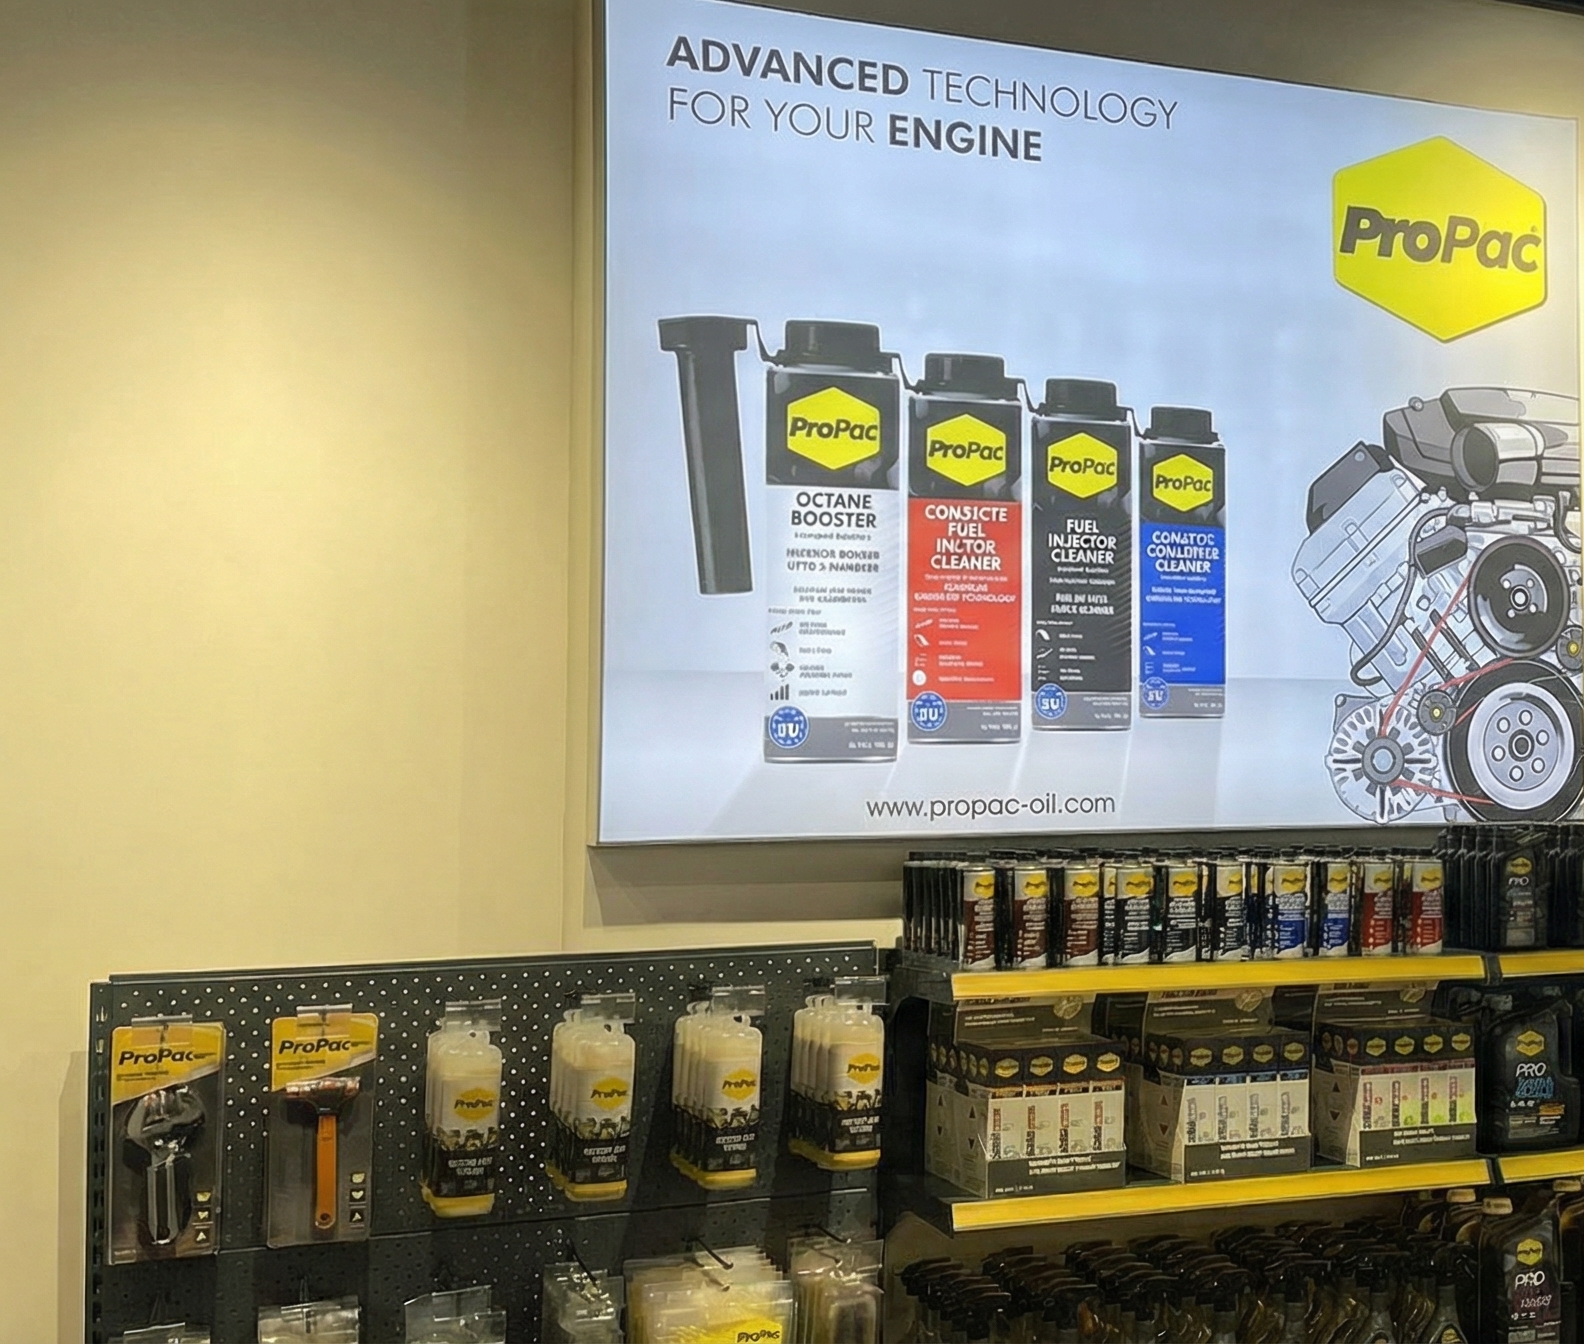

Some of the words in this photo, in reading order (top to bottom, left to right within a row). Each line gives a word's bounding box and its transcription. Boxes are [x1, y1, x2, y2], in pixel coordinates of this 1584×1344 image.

[666, 36, 909, 95] ADVANCED
[923, 68, 1178, 129] TECHNOLOGY
[669, 87, 752, 129] FOR
[769, 103, 875, 143] YOUR
[888, 114, 1043, 161] ENGINE
[1339, 205, 1542, 273] ProPac
[789, 417, 878, 441] ProPac
[928, 440, 1004, 461] ProPac
[1049, 456, 1115, 476] ProPac
[1155, 474, 1212, 492] ProPac
[796, 492, 872, 509] OCTANE
[791, 510, 877, 528] BOOSTER
[1066, 519, 1099, 533] FUEL
[948, 522, 986, 537] FUEL
[1049, 533, 1117, 549] INJECTOR
[931, 555, 1001, 570] CLEANER
[1051, 549, 1114, 564] CLEANER
[1155, 559, 1211, 573] CLEANER
[866, 793, 1115, 821] www.propac-oil.com
[279, 1038, 351, 1055] ProPac
[118, 1048, 194, 1066] ProPac
[1516, 1062, 1547, 1077] PRO
[1515, 1270, 1546, 1289] PRO
